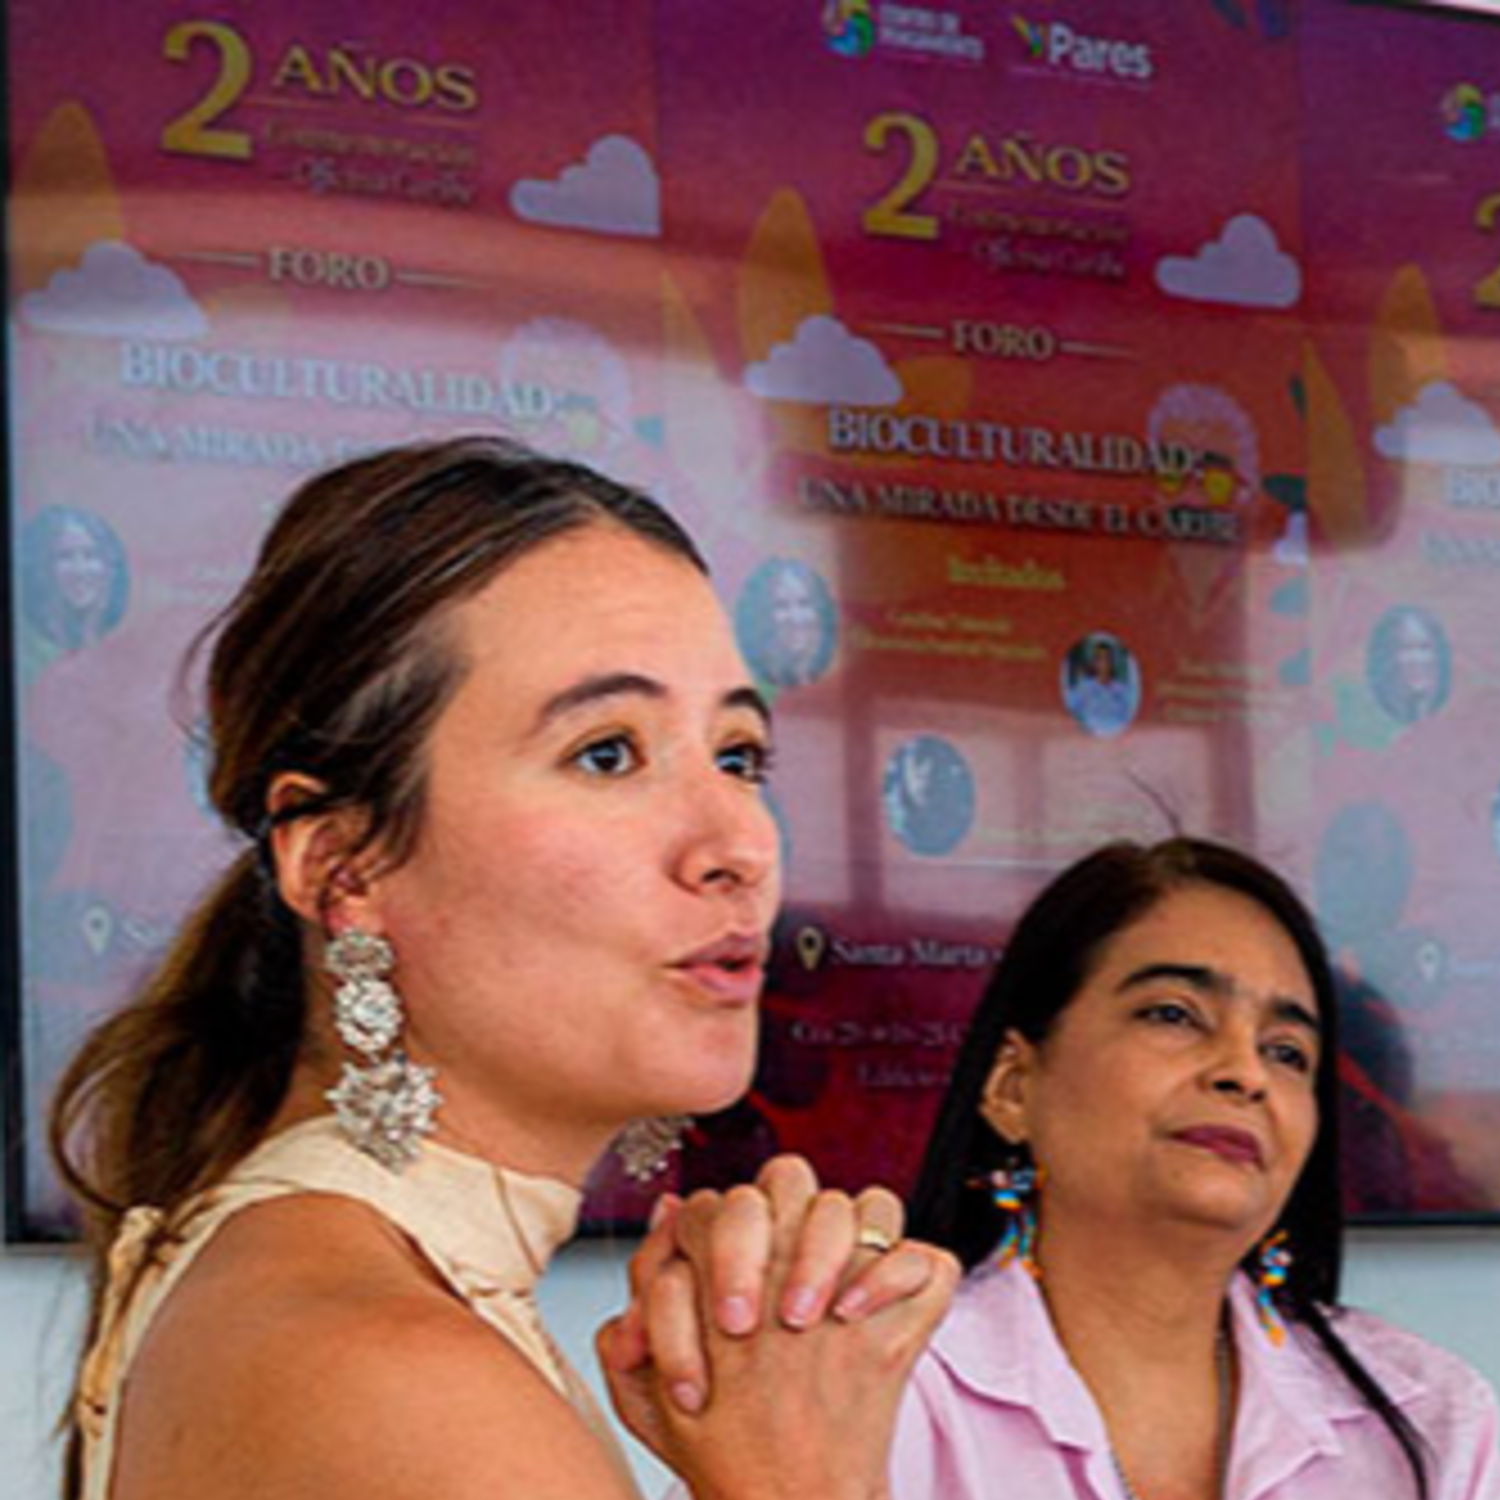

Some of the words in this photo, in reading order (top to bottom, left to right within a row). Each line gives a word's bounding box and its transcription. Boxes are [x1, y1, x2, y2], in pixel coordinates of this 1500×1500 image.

[1047, 21, 1152, 80] Pares
[160, 20, 254, 158] 2
[272, 43, 480, 110] AÑOS
[862, 110, 940, 240] 2
[954, 132, 1131, 194] AÑOS
[268, 246, 390, 290] FORO
[951, 319, 1056, 360] FORO
[873, 484, 999, 525] MIRADA
[832, 938, 904, 967] Santa
[908, 938, 987, 967] Marta
